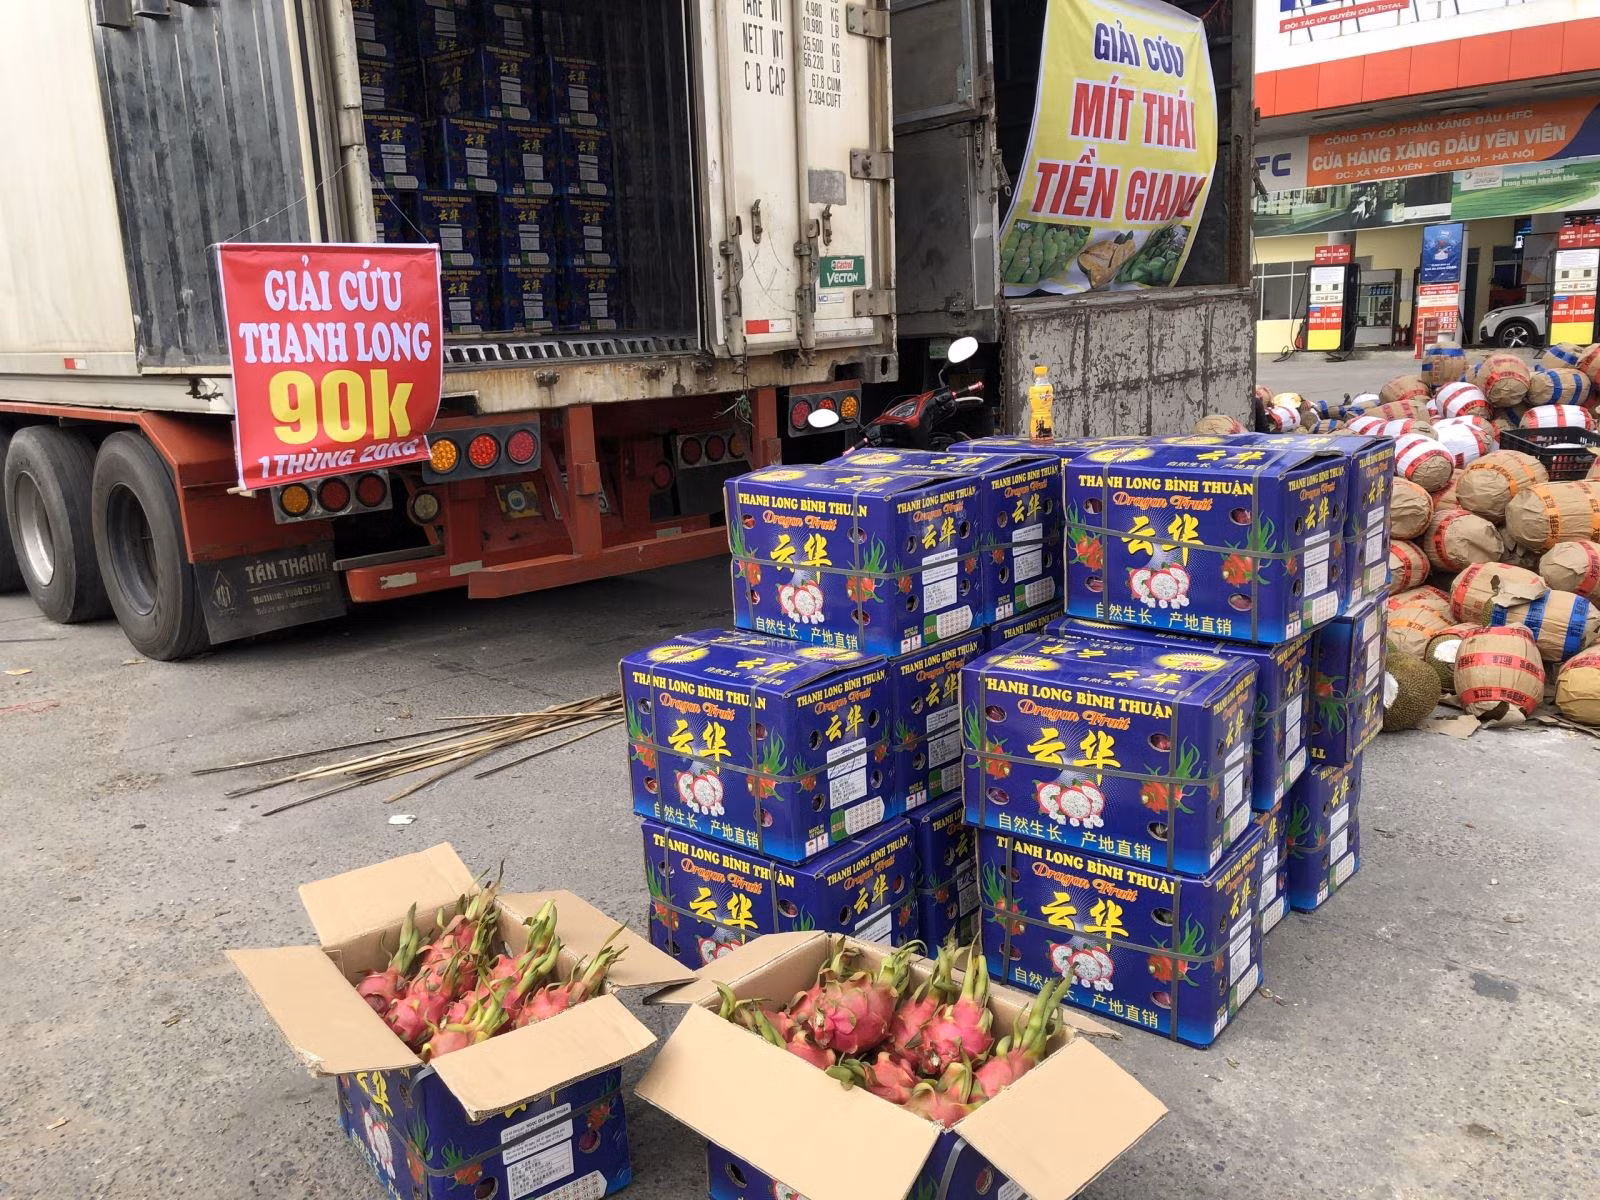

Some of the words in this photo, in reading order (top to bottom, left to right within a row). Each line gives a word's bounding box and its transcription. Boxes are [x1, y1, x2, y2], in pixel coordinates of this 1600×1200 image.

[805, 2, 822, 18] 4.980
[831, 8, 839, 22] KG
[743, 22, 763, 55] NETT
[772, 29, 783, 60] WT
[803, 17, 822, 34] 10.980
[832, 25, 839, 38] LB
[803, 37, 823, 53] 25.500
[832, 43, 840, 57] KG
[1094, 19, 1141, 67] GIẢI
[1143, 36, 1183, 77] CỨU
[804, 53, 823, 70] 56.220
[832, 60, 840, 73] LB
[745, 61, 750, 90] C
[756, 63, 761, 92] B
[769, 66, 785, 96] CAP
[812, 74, 824, 88] 67.8
[827, 77, 841, 92] CUM
[809, 89, 825, 104] 2.394
[826, 92, 841, 108] CUFT
[1071, 76, 1134, 141] MÍT
[1142, 90, 1196, 150] THÁI
[1361, 131, 1375, 142] TY
[1506, 109, 1533, 120] HFC
[1312, 149, 1343, 171] CỬA
[1347, 145, 1391, 167] HÀNG
[1395, 136, 1440, 161] XĂNG
[1444, 130, 1480, 153] DẦU
[1484, 128, 1519, 148] YÊN
[1524, 122, 1566, 144] VIÊN
[1374, 163, 1395, 175] YÊN
[1396, 160, 1423, 172] VIÊN
[1433, 158, 1452, 168] GIA
[1032, 148, 1118, 218] TIỀN
[1125, 170, 1208, 221] GIANG
[264, 254, 332, 312] GIẢI
[338, 259, 401, 312] CỨU
[827, 272, 858, 286] VECTON
[239, 322, 349, 364] THANH
[354, 322, 432, 363] LONG
[258, 458, 270, 479] 1
[274, 447, 353, 477] THÙNG
[1078, 475, 1123, 488] THANH
[1126, 477, 1160, 490] LONG
[738, 493, 769, 506] THANH
[772, 496, 798, 510] LONG
[896, 502, 921, 514] THANH
[921, 497, 940, 510] LONG
[1113, 492, 1167, 510] Dragon
[1170, 495, 1213, 510] Fruit
[762, 510, 803, 528] Dragon
[805, 515, 838, 531] Fruit
[921, 518, 957, 550] 云华
[1121, 513, 1204, 567] 云华
[770, 533, 832, 585] 云华
[901, 661, 923, 676] THANH
[924, 654, 941, 668] LONG
[632, 672, 666, 689] THANH
[668, 679, 695, 694] LONG
[797, 692, 823, 707] THANH
[824, 685, 842, 700] LONG
[1032, 684, 1073, 703] LONG
[660, 692, 701, 713] Dragon
[702, 702, 735, 720] Fruit
[815, 697, 847, 714] Dragon
[1017, 698, 1079, 722] Dragon
[1082, 710, 1130, 730] Fruit
[825, 705, 865, 742] 云华
[668, 719, 732, 775] 云华
[1027, 727, 1121, 786] 云华
[691, 846, 720, 864] LONG
[1046, 849, 1084, 870] LONG
[681, 855, 725, 883] Dragon
[727, 871, 762, 894] Fruit
[826, 868, 851, 886] THANH
[852, 859, 869, 875] LONG
[844, 869, 874, 890] Dragon
[1032, 861, 1090, 889] Dragon
[1092, 878, 1138, 902] Fruit
[853, 873, 890, 915] 云华
[689, 886, 759, 944] 云华
[1040, 891, 1129, 952] 云华
[1092, 992, 1159, 1030] 产地直销
